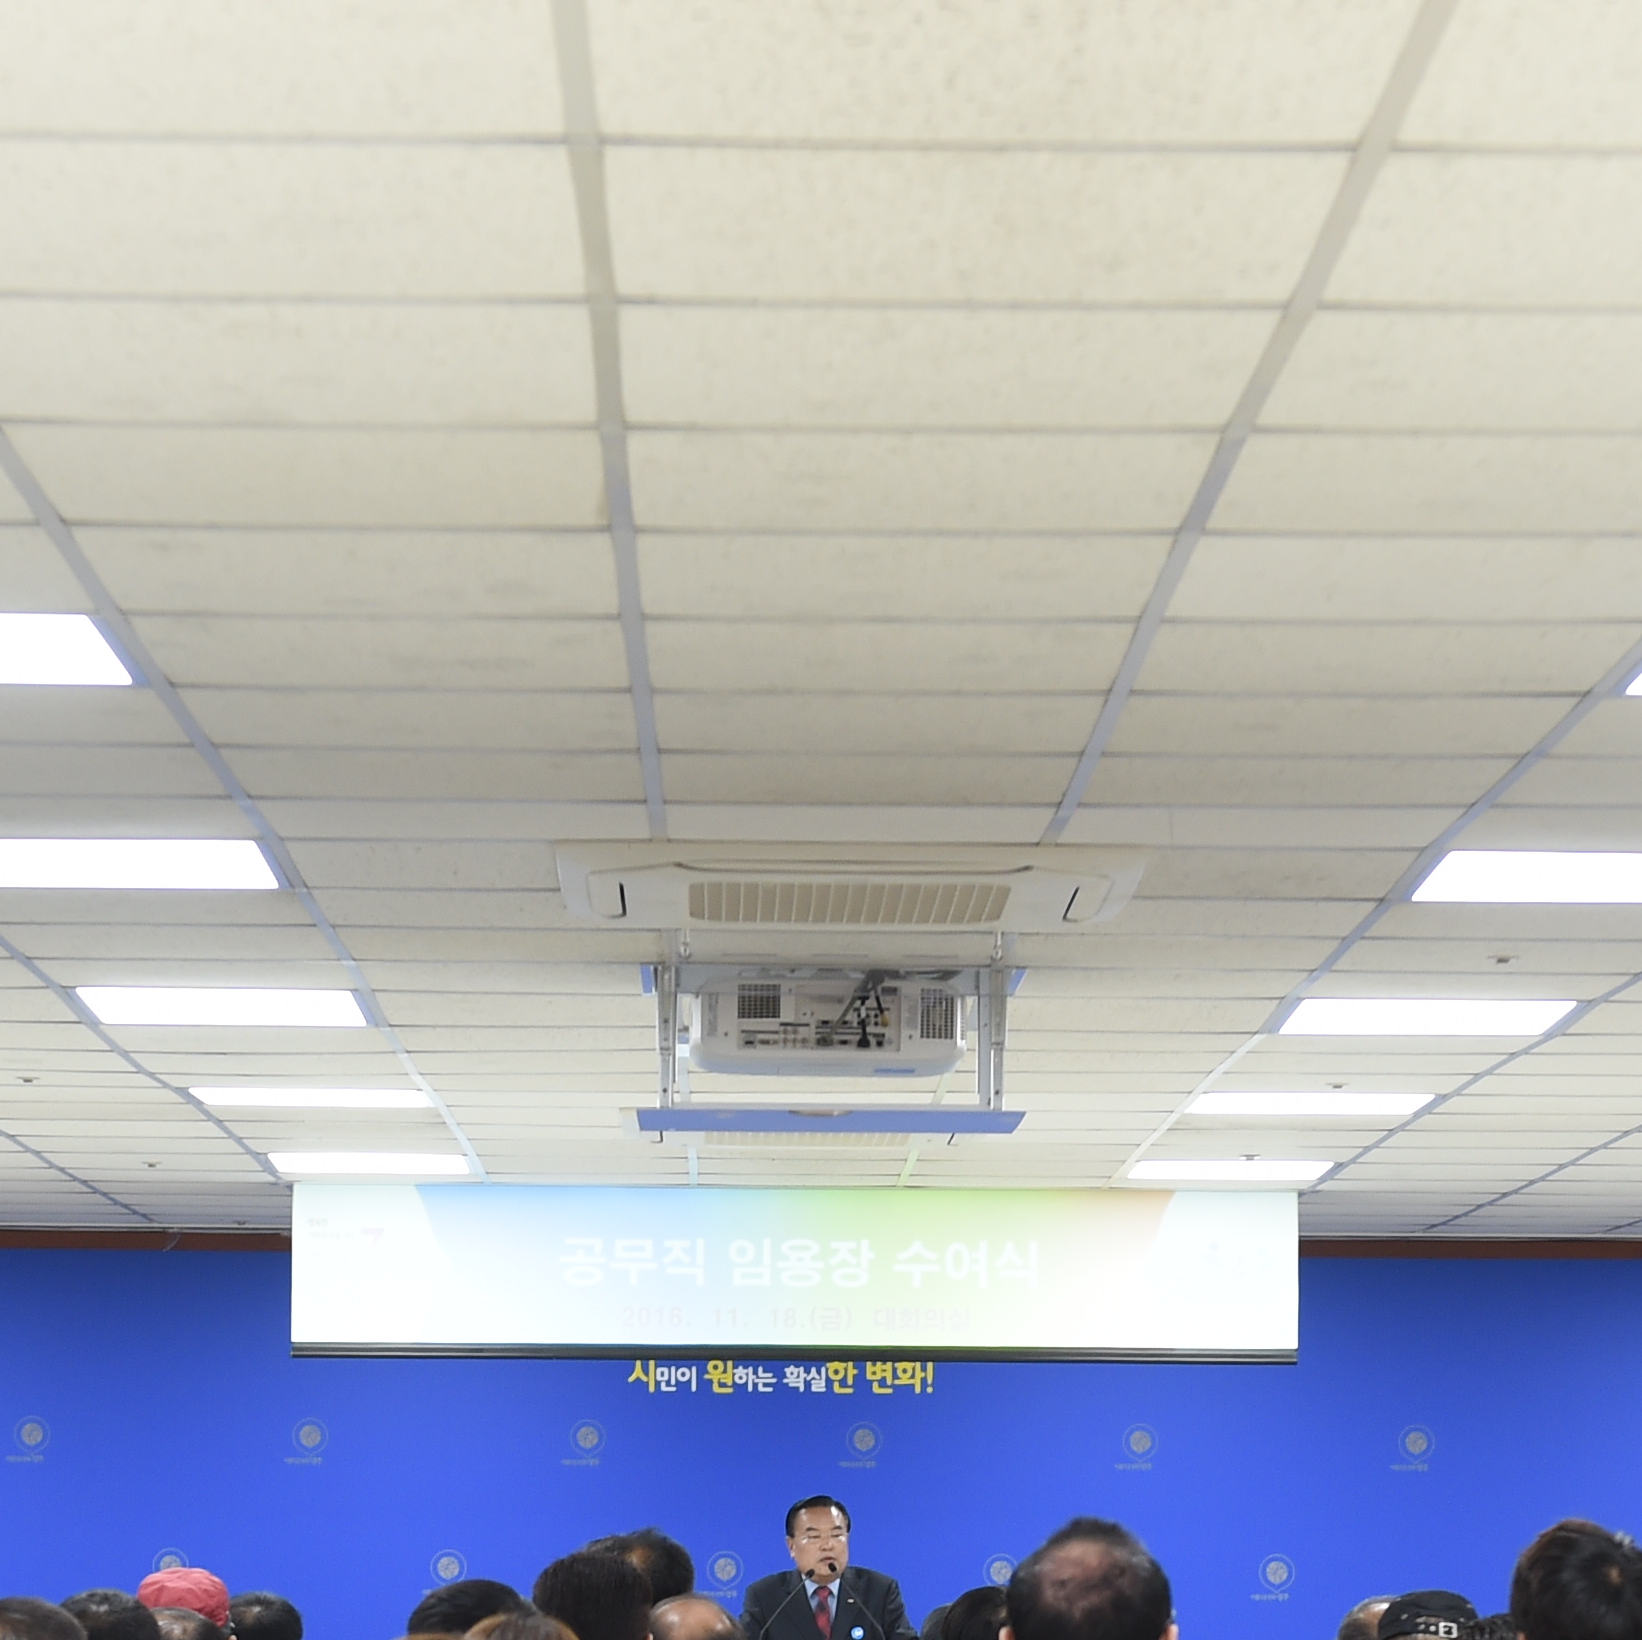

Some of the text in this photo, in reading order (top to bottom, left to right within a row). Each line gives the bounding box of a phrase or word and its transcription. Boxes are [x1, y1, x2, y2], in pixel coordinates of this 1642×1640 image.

[558, 1237, 1040, 1290] 공무직 임용장 수여식
[621, 1306, 692, 1329] 2016.
[714, 1306, 750, 1329] 11.
[628, 1359, 934, 1394] 시민이 원하는 확실한 변화!
